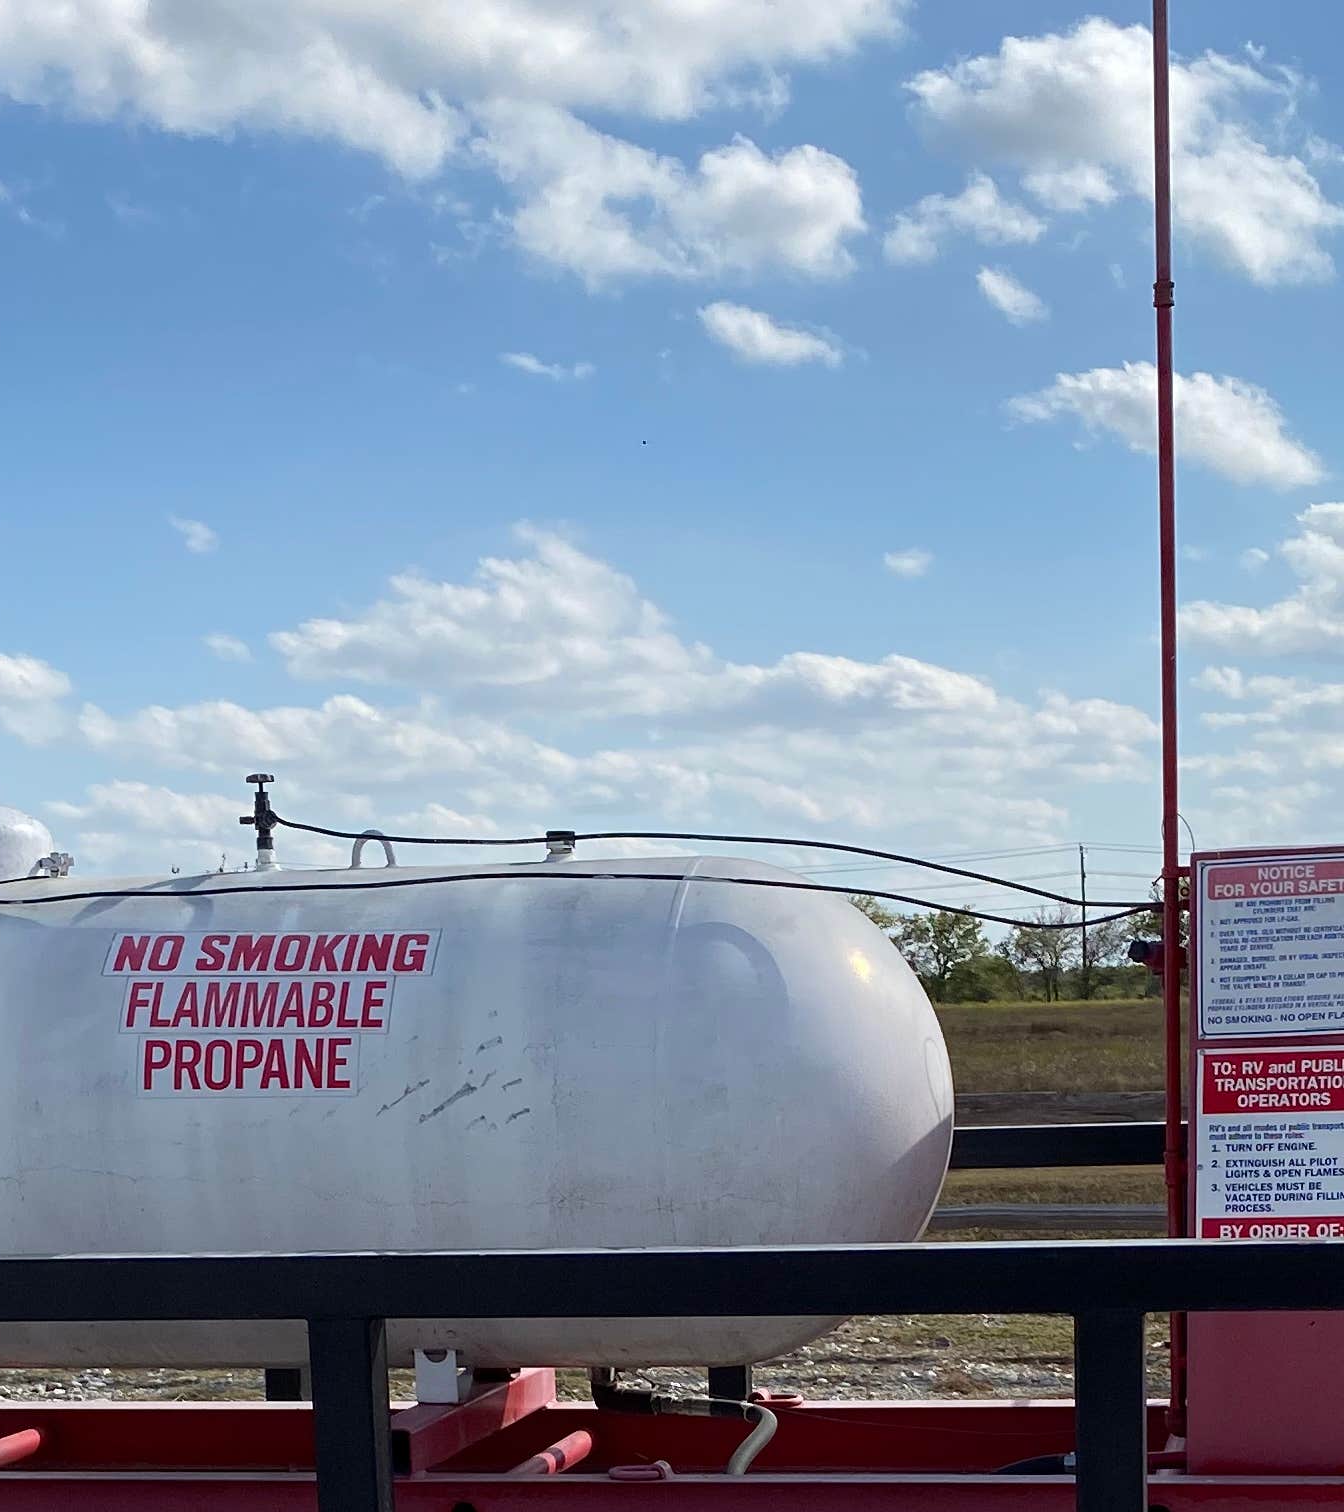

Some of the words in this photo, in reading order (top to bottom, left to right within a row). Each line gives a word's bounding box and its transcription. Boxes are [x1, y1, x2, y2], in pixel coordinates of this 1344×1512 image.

[1257, 865, 1315, 879] NOTICE
[1214, 884, 1245, 897] FOR
[1250, 881, 1295, 895] YOUR
[112, 934, 185, 972] NO
[196, 933, 431, 972] SMOKING
[126, 980, 389, 1028] FLAMMABLE
[1225, 1015, 1273, 1024] SMOKING
[1280, 1014, 1295, 1022] NO
[1298, 1012, 1325, 1021] OPEN
[143, 1037, 353, 1090] PROPANE
[1211, 1062, 1237, 1075] TO:
[1242, 1061, 1263, 1074] RV
[1268, 1061, 1296, 1073] and
[1237, 1093, 1331, 1107] OPERATORS
[1228, 1124, 1241, 1132] and
[1289, 1122, 1310, 1132] public
[1211, 1144, 1221, 1152] 1.
[1225, 1143, 1252, 1152] TURN
[1255, 1143, 1275, 1151] OFF
[1277, 1142, 1317, 1151] ENGINE.
[1211, 1160, 1220, 1169] 2.
[1225, 1159, 1285, 1168] EXTINGUISH
[1288, 1158, 1307, 1167] ALL
[1309, 1158, 1339, 1166] PILOT
[1225, 1170, 1260, 1178] LIGHTS
[1275, 1169, 1301, 1177] OPEN
[1211, 1183, 1220, 1192] 3.
[1225, 1183, 1273, 1192] VEHICLES
[1276, 1182, 1305, 1191] MUST
[1308, 1182, 1322, 1190] BE
[1225, 1193, 1271, 1202] VACATED
[1274, 1193, 1313, 1201] DURING
[1225, 1204, 1275, 1213] PROCESS.
[1220, 1225, 1243, 1238] BY
[1249, 1224, 1310, 1238] ORDER
[1316, 1223, 1344, 1237] OF:
